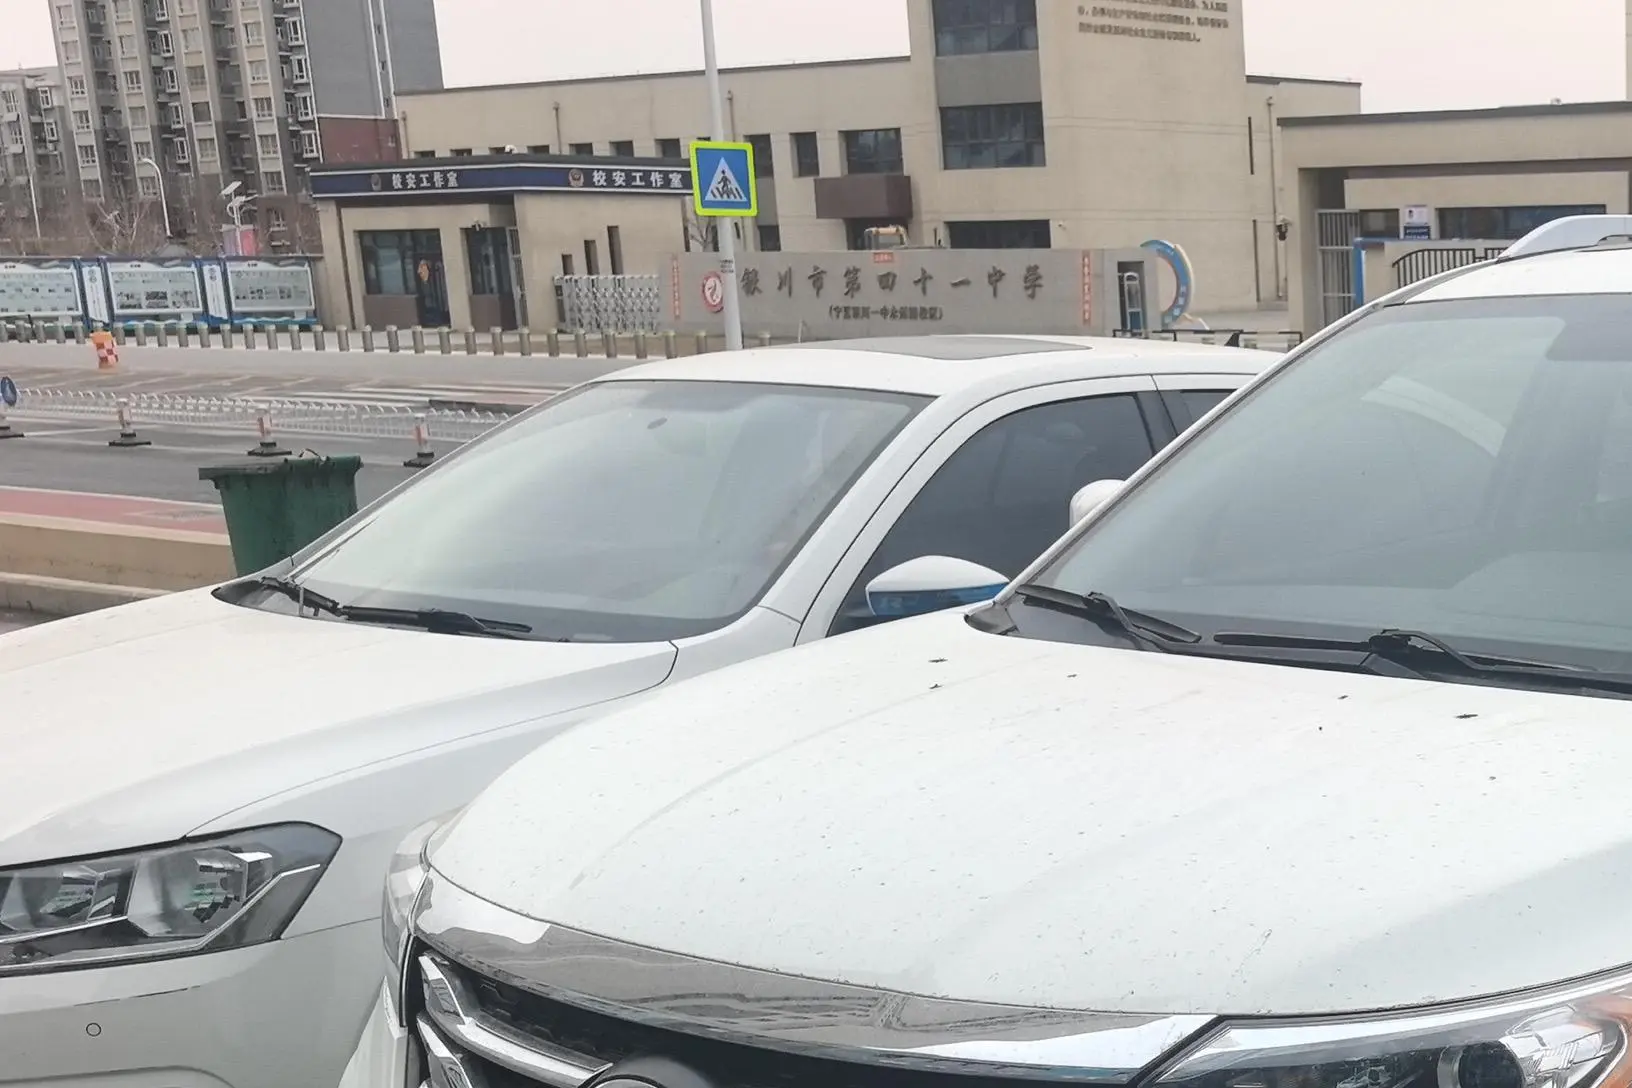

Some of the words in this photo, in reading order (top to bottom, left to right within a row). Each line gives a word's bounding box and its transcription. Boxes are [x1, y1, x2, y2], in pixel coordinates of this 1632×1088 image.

[391, 171, 459, 189] 校安工作室
[592, 169, 684, 188] 校安工作室
[740, 264, 1044, 300] 银川市第四十一中学
